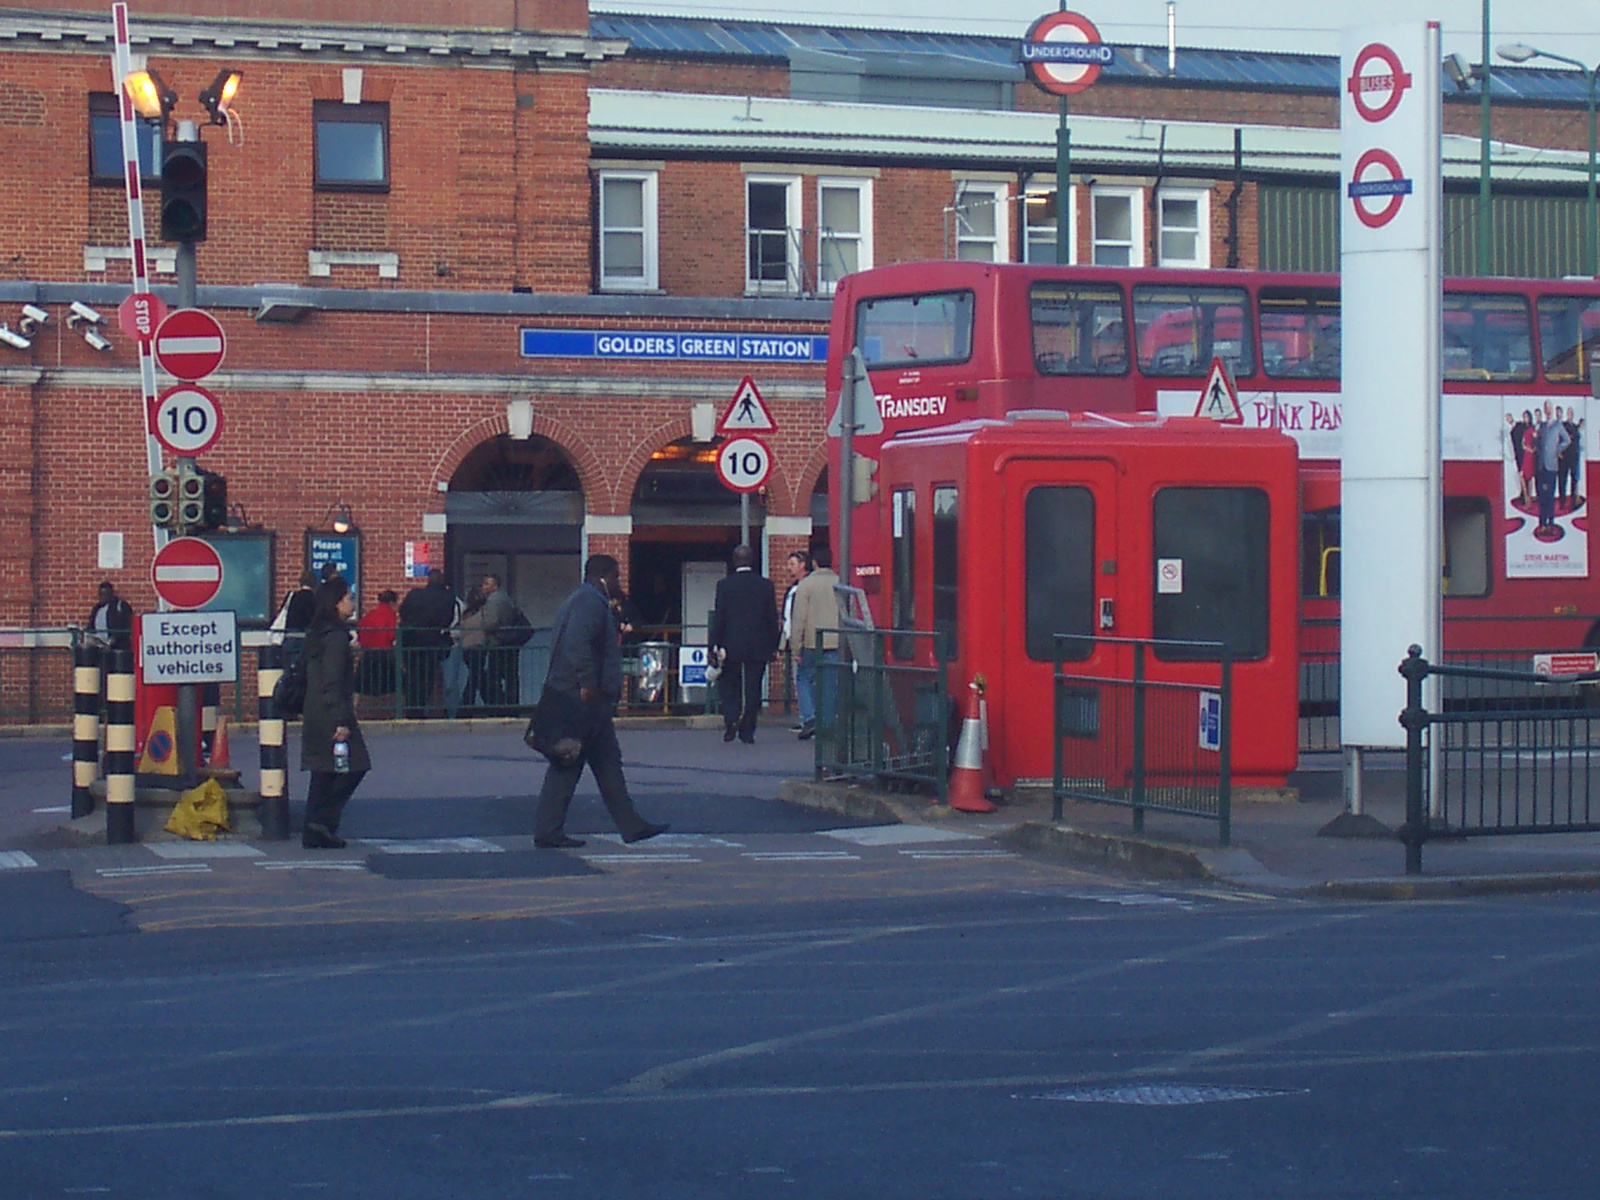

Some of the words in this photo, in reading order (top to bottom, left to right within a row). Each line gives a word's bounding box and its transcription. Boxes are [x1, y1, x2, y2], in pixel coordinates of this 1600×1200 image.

[1023, 44, 1112, 61] UNDERGROUND
[1360, 76, 1395, 92] BUSES
[134, 300, 150, 335] STOP
[598, 336, 676, 354] GOLDERS
[681, 338, 736, 355] GREEN
[741, 340, 811, 357] STATION
[875, 394, 947, 418] TRANSDEV
[167, 406, 208, 435] 10
[1253, 401, 1304, 431] PINK
[728, 452, 761, 476] 10
[312, 540, 342, 551] Please
[312, 551, 329, 560] use
[160, 621, 218, 638] Except
[146, 639, 233, 656] authorised
[157, 660, 224, 675] vehicles
